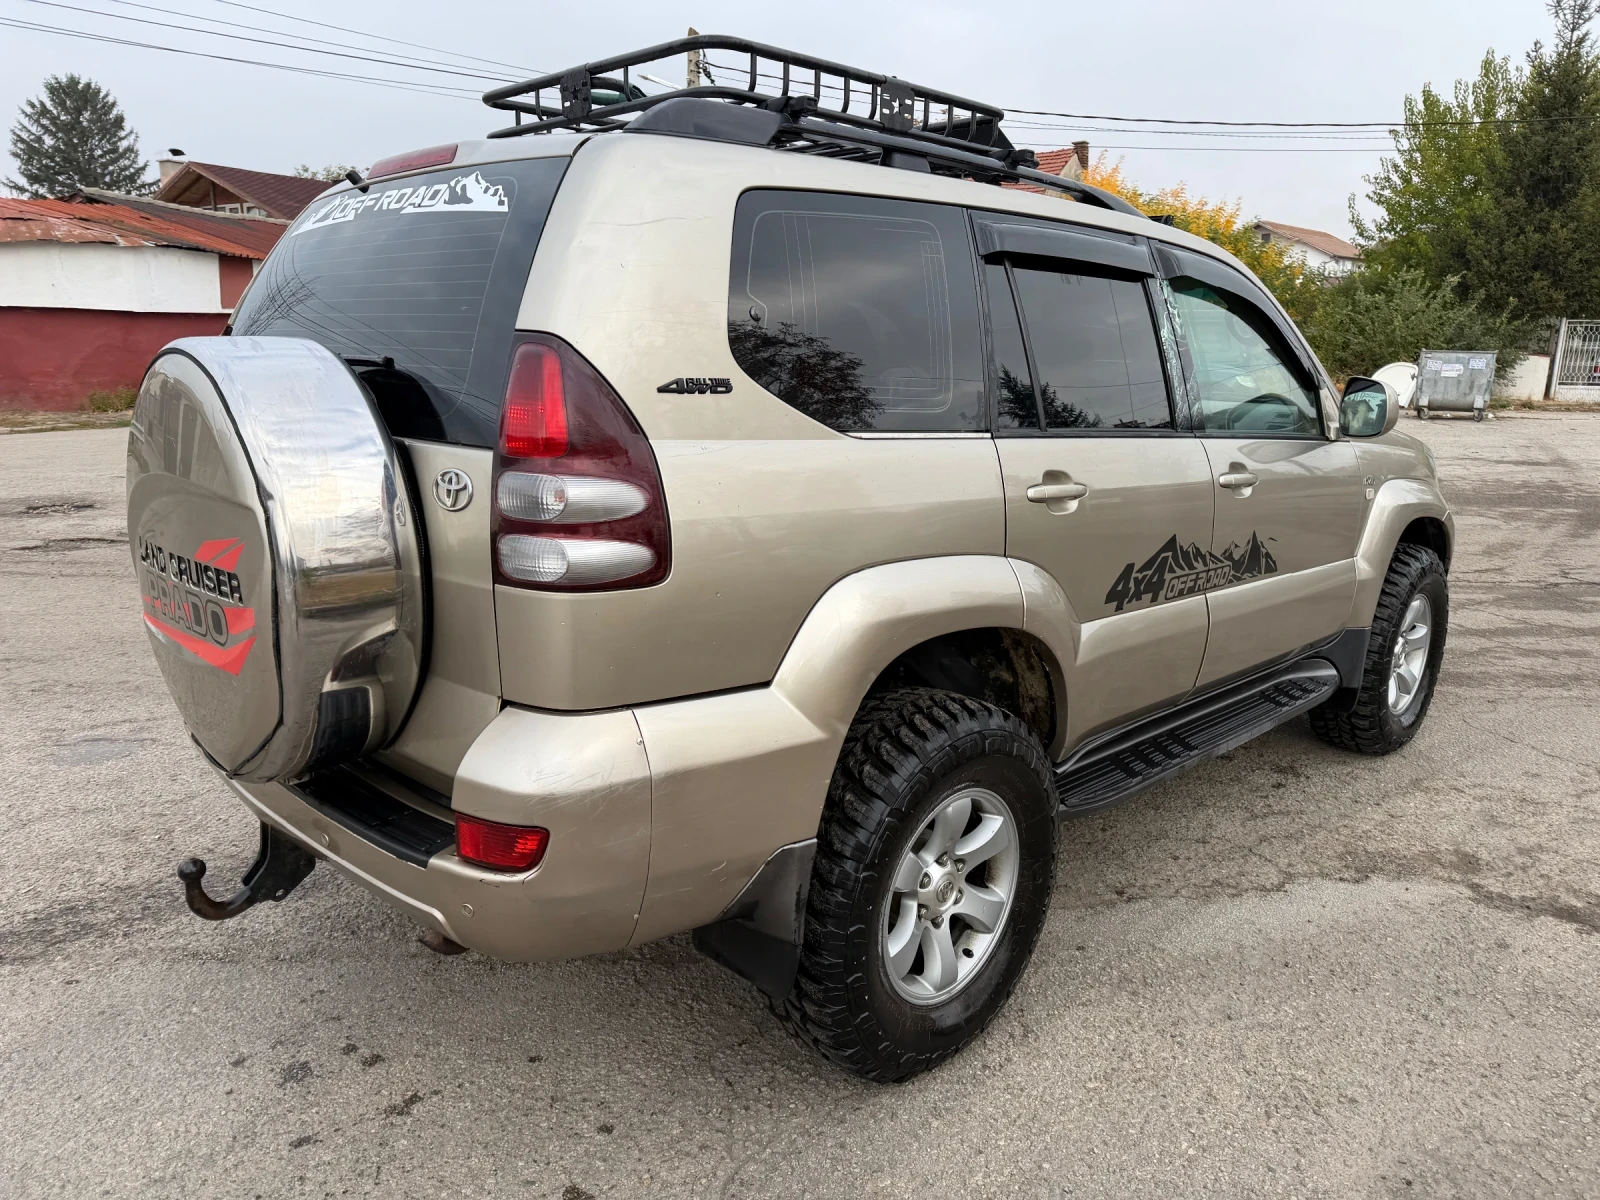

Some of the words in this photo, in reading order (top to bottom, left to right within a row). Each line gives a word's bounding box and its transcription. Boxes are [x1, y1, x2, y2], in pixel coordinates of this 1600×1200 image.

[334, 193, 381, 218] OFF
[374, 184, 448, 211] ROAD
[656, 377, 733, 394] 4WD
[169, 552, 244, 606] CRUISER
[1167, 576, 1195, 598] OFF
[1195, 568, 1230, 590] ROAD
[146, 569, 229, 647] PRADO
